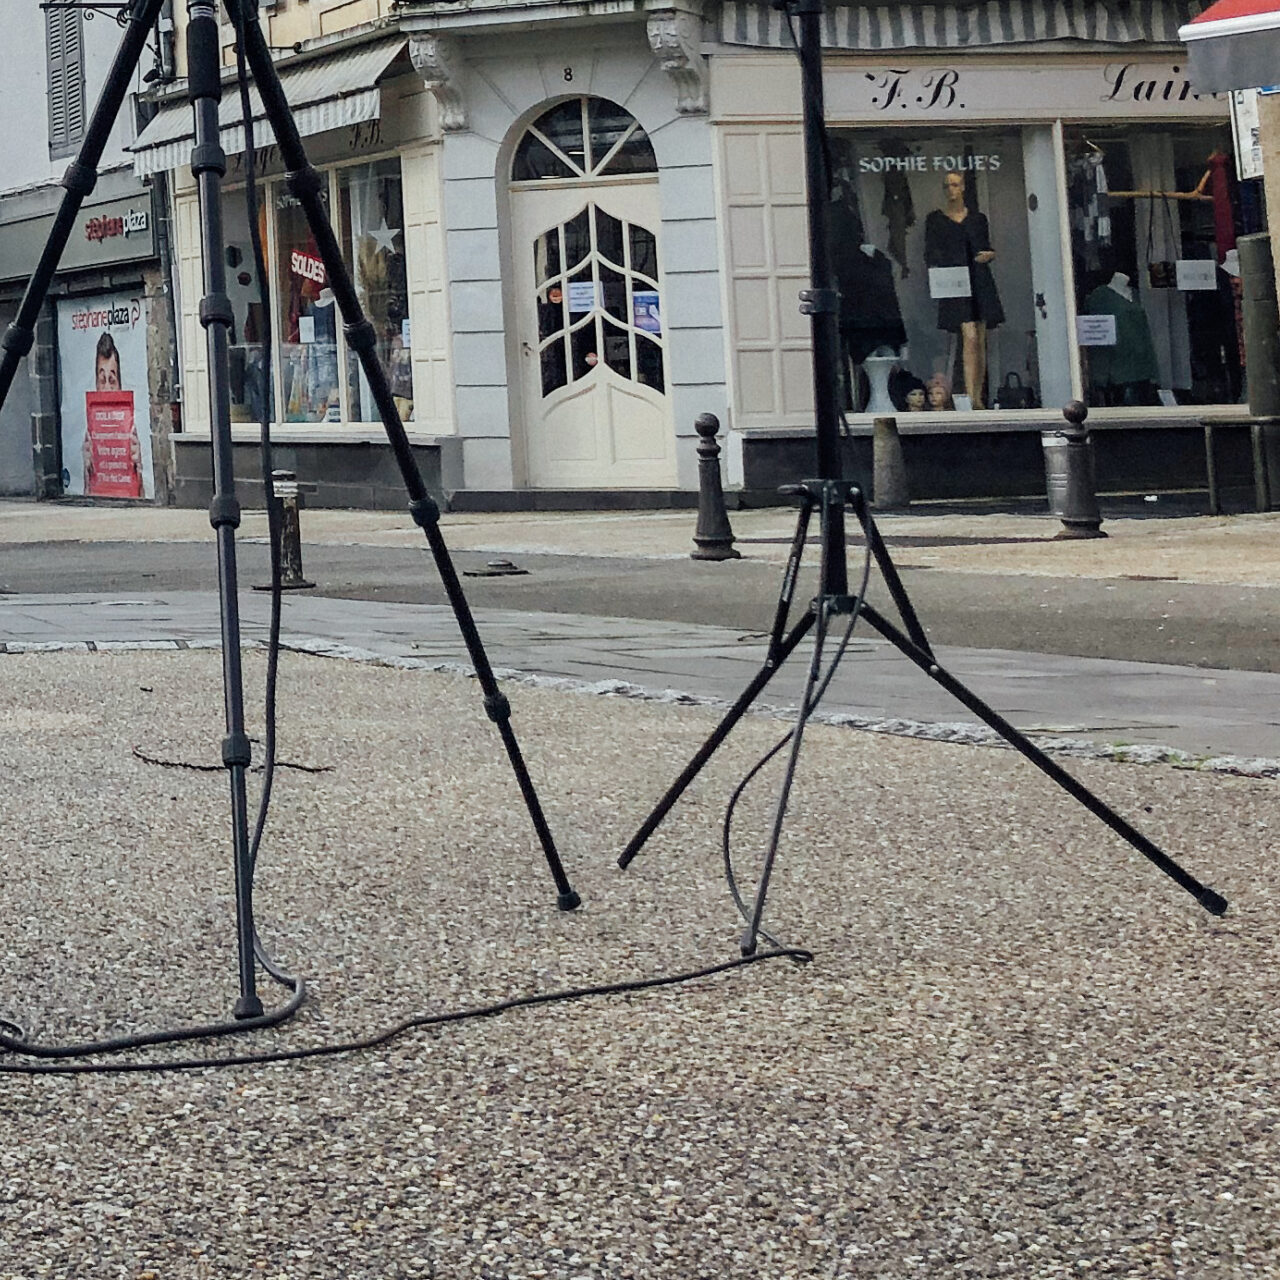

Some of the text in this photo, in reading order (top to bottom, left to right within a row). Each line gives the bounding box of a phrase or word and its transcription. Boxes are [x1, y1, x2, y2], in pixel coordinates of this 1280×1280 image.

[563, 67, 573, 81] 8
[858, 156, 927, 172] SOPHIE
[291, 252, 325, 284] SOLDES
